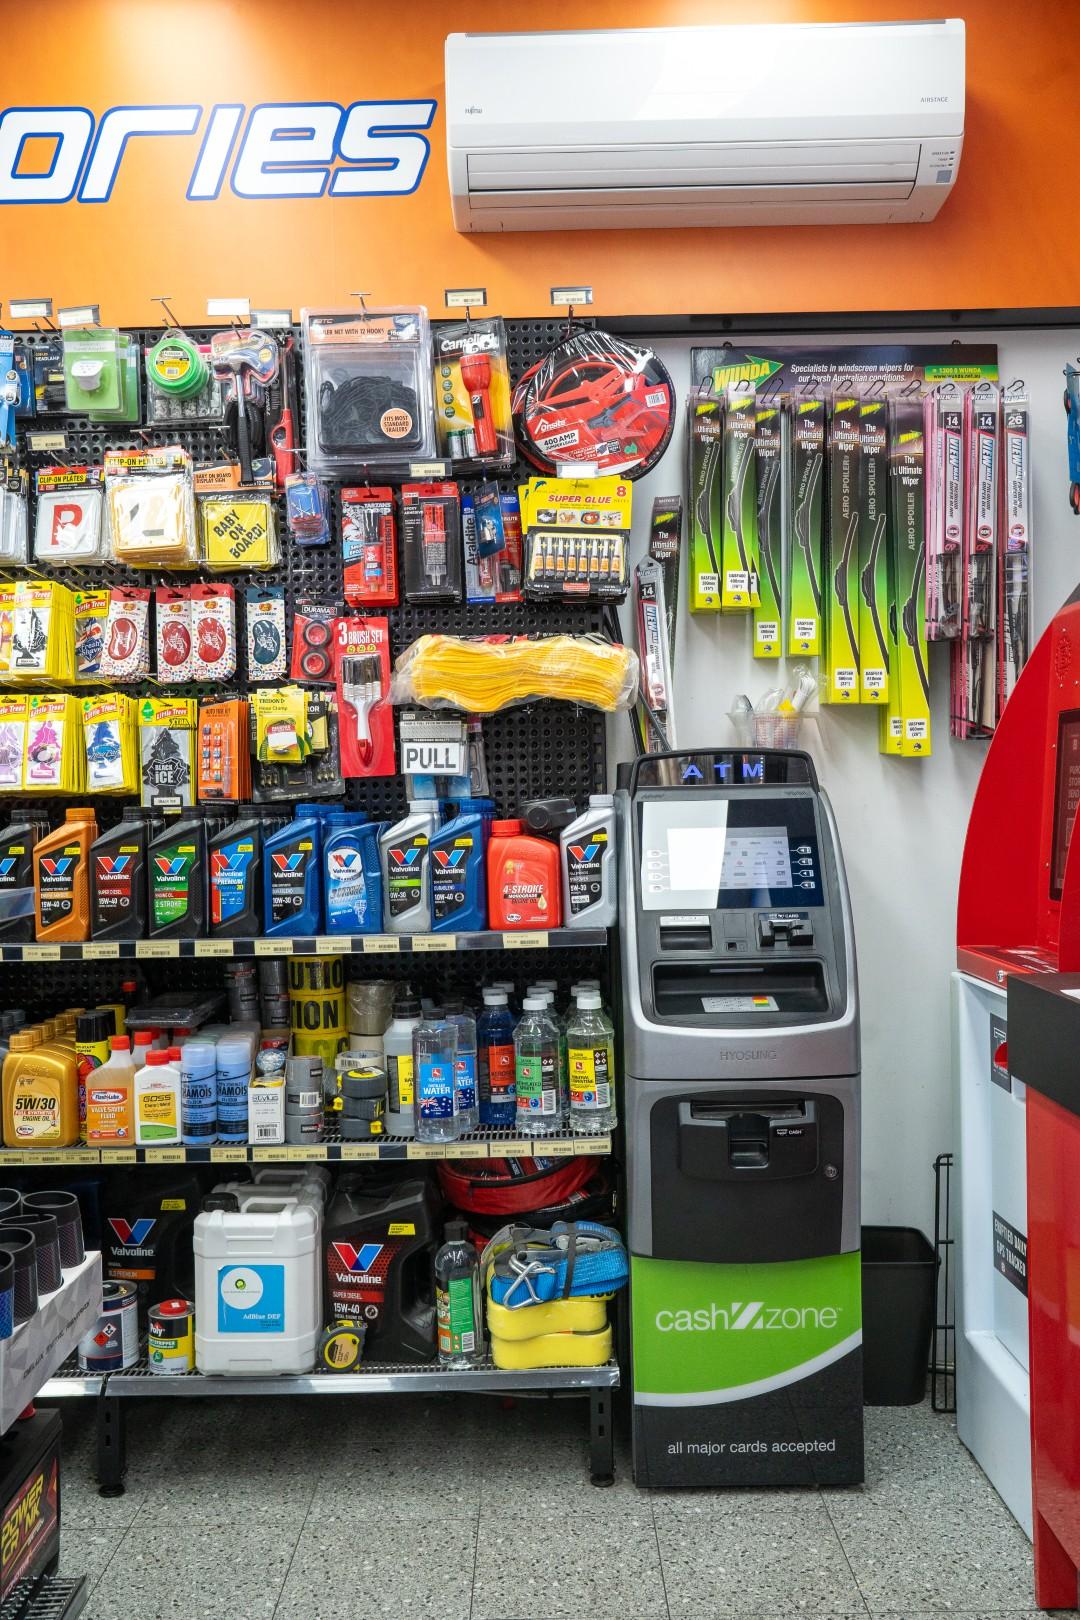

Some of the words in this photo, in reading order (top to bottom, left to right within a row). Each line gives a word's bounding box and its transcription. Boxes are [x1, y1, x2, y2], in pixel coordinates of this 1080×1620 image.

[345, 328, 358, 336] WITH
[714, 361, 770, 393] WUNDA
[790, 364, 828, 374] Specialists
[830, 364, 837, 372] in
[839, 363, 874, 372] windscreen
[875, 363, 901, 375] wipers
[902, 362, 914, 372] for
[798, 375, 810, 384] our
[832, 373, 866, 383] Australian
[868, 373, 906, 383] conditions.
[702, 416, 712, 425] The
[736, 412, 746, 422] The
[946, 416, 959, 426] 14
[980, 416, 992, 426] 14
[1008, 416, 1023, 425] 26
[730, 422, 752, 430] Ultimate
[804, 420, 816, 428] The
[840, 420, 852, 429] The
[864, 424, 876, 432] The
[697, 426, 718, 434] Ultimate
[734, 430, 749, 440] Wiper
[760, 428, 771, 436] The
[798, 430, 822, 439] Ultimate
[544, 436, 559, 446] 400
[560, 432, 576, 443] AMP
[700, 434, 715, 444] Wiper
[834, 431, 859, 440] Ultimate
[860, 434, 886, 443] Ultimate
[755, 438, 779, 447] Ultimate
[801, 441, 818, 452] Wiper
[838, 442, 854, 452] Wiper
[758, 448, 776, 458] Wiper
[863, 444, 880, 454] Wiper
[902, 455, 914, 464] The
[898, 466, 922, 476] Ultimate
[40, 476, 62, 484] CLIP-ON
[63, 474, 84, 482] PLATES
[902, 476, 919, 486] Wiper
[616, 486, 627, 497] 8
[548, 494, 582, 503] SUPER
[585, 496, 612, 504] GLUE
[50, 503, 82, 546] P
[213, 509, 240, 538] BABY
[229, 523, 247, 541] ON
[229, 523, 266, 559] BOARD!
[466, 518, 477, 566] Araldite
[652, 540, 677, 548] Ultimate
[656, 550, 672, 558] Wiper
[641, 587, 654, 596] 14
[75, 602, 91, 615] Little
[338, 622, 348, 646] 3
[348, 630, 370, 644] BRUSH
[372, 630, 384, 643] SET
[30, 708, 47, 718] Little
[49, 704, 64, 712] Trees
[84, 710, 101, 721] Little
[102, 704, 117, 714] Trees
[156, 711, 172, 720] Little
[173, 708, 188, 716] Trees
[406, 748, 456, 768] PULL
[503, 884, 543, 894] 4-STROKE
[434, 893, 454, 901] 10W-40
[720, 1050, 777, 1060] HYOSUNG
[424, 1087, 450, 1095] WATER
[16, 1096, 56, 1110] 5W/30
[994, 1218, 1013, 1245] EMPTIED
[1014, 1235, 1027, 1257] DAILY
[111, 1247, 155, 1257] Valvoline
[996, 1240, 1005, 1258] GPS
[1006, 1248, 1026, 1277] TRACKED
[336, 1273, 382, 1284] Valvoline
[334, 1303, 360, 1314] 15W-40
[655, 1302, 728, 1332] cash
[765, 1307, 838, 1330] zone
[667, 1442, 682, 1454] all
[687, 1442, 726, 1456] major
[730, 1440, 768, 1453] cards
[772, 1439, 836, 1455] accepted
[1, 1473, 44, 1548] POWER
